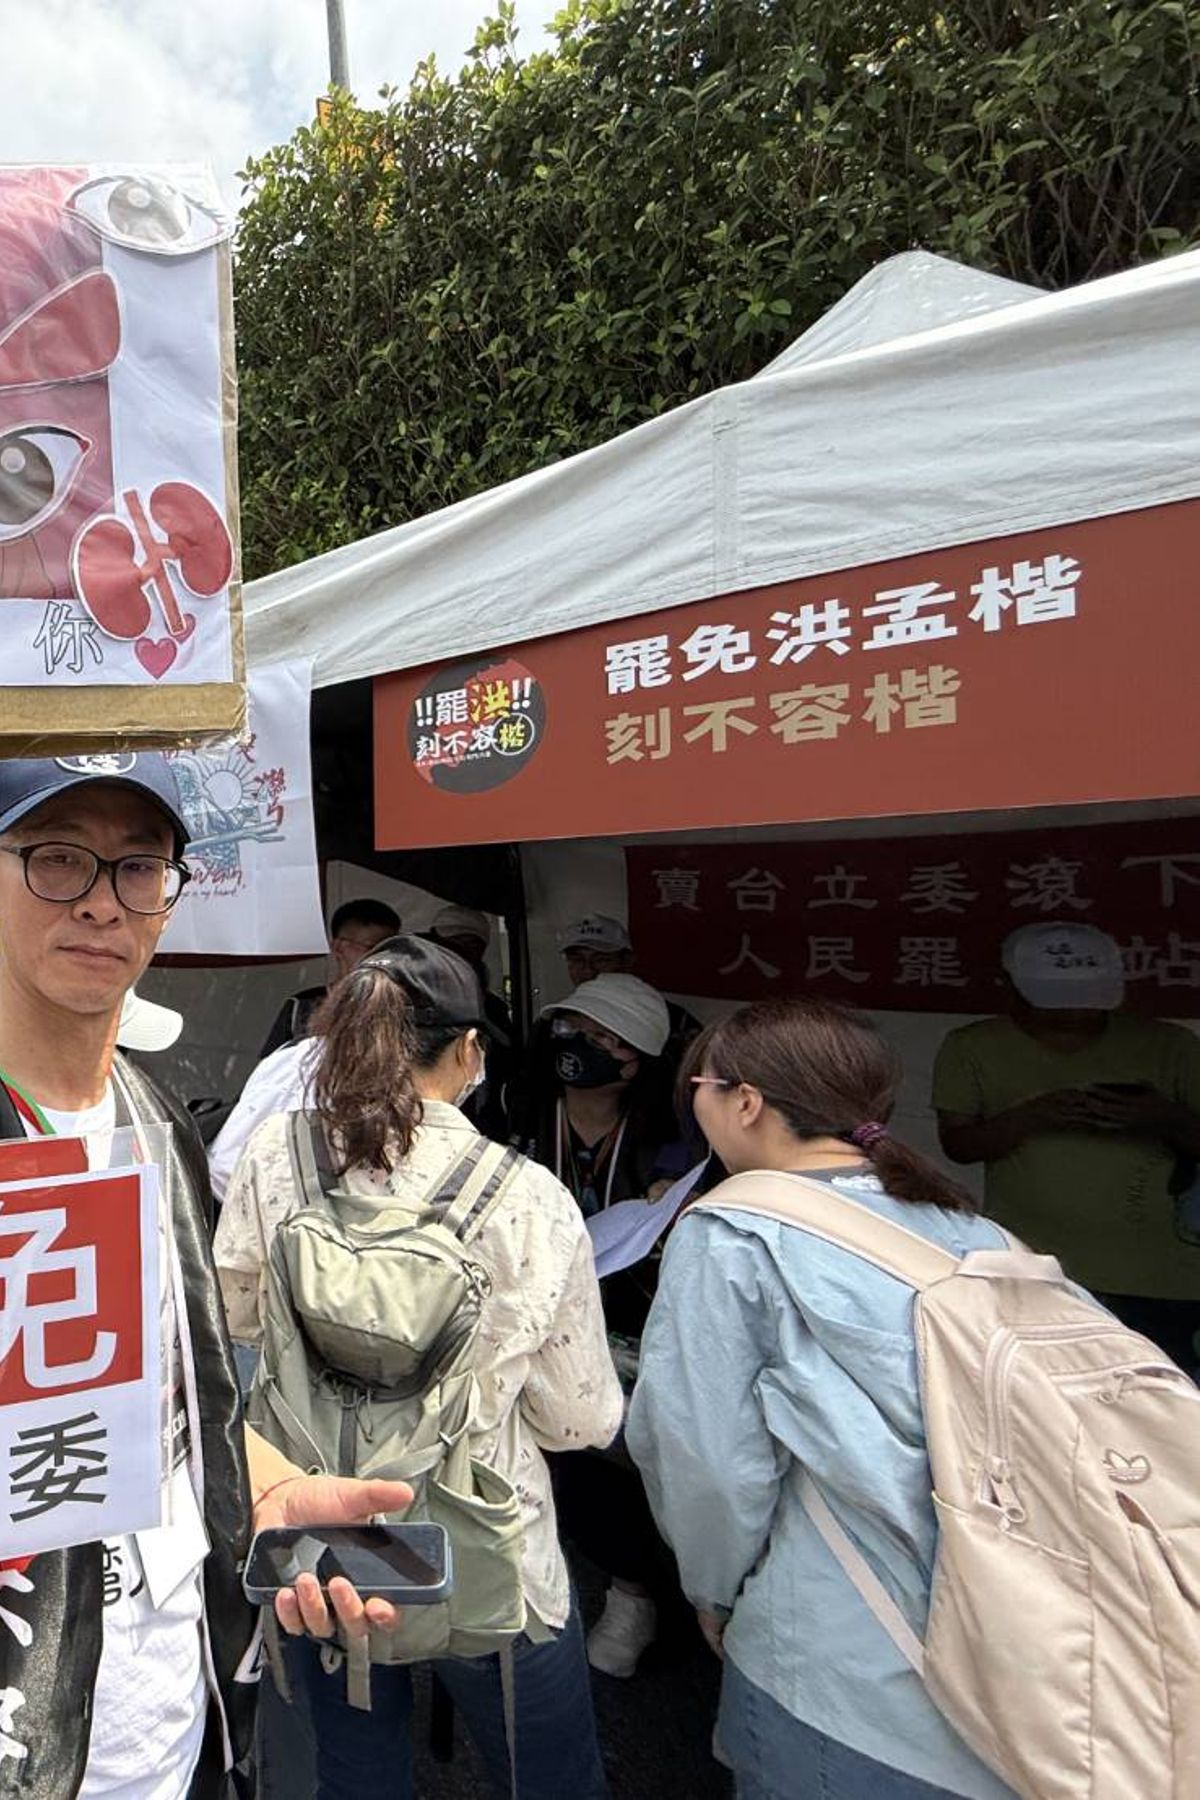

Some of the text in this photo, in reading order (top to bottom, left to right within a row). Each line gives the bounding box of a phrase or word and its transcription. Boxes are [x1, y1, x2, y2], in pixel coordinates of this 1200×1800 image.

[605, 554, 1083, 695] 罷免洪孟楷
[605, 666, 962, 766] 刻不容楷
[718, 931, 1200, 988] 人民罷站
